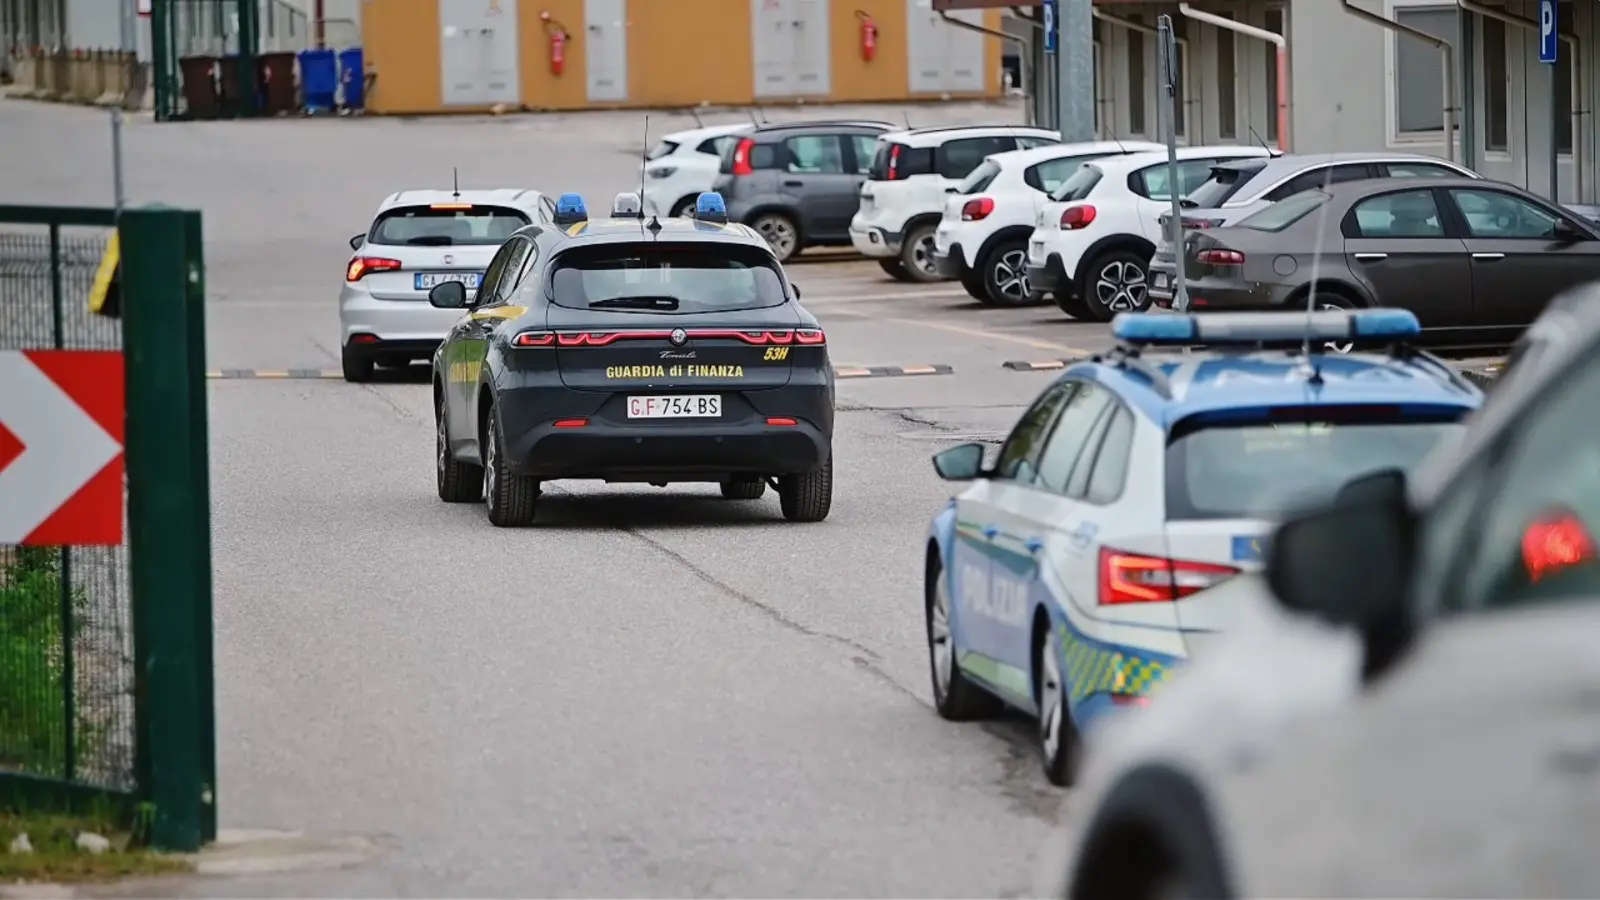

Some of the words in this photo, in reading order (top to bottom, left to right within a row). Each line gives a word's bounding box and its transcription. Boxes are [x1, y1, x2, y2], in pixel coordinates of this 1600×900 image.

[1044, 3, 1053, 47] P
[1541, 1, 1553, 55] P
[763, 347, 789, 360] 53H
[606, 365, 665, 378] GUARDIA
[669, 365, 682, 377] di
[687, 365, 744, 377] FINANZA
[662, 398, 692, 415] 754
[698, 397, 717, 414] BS
